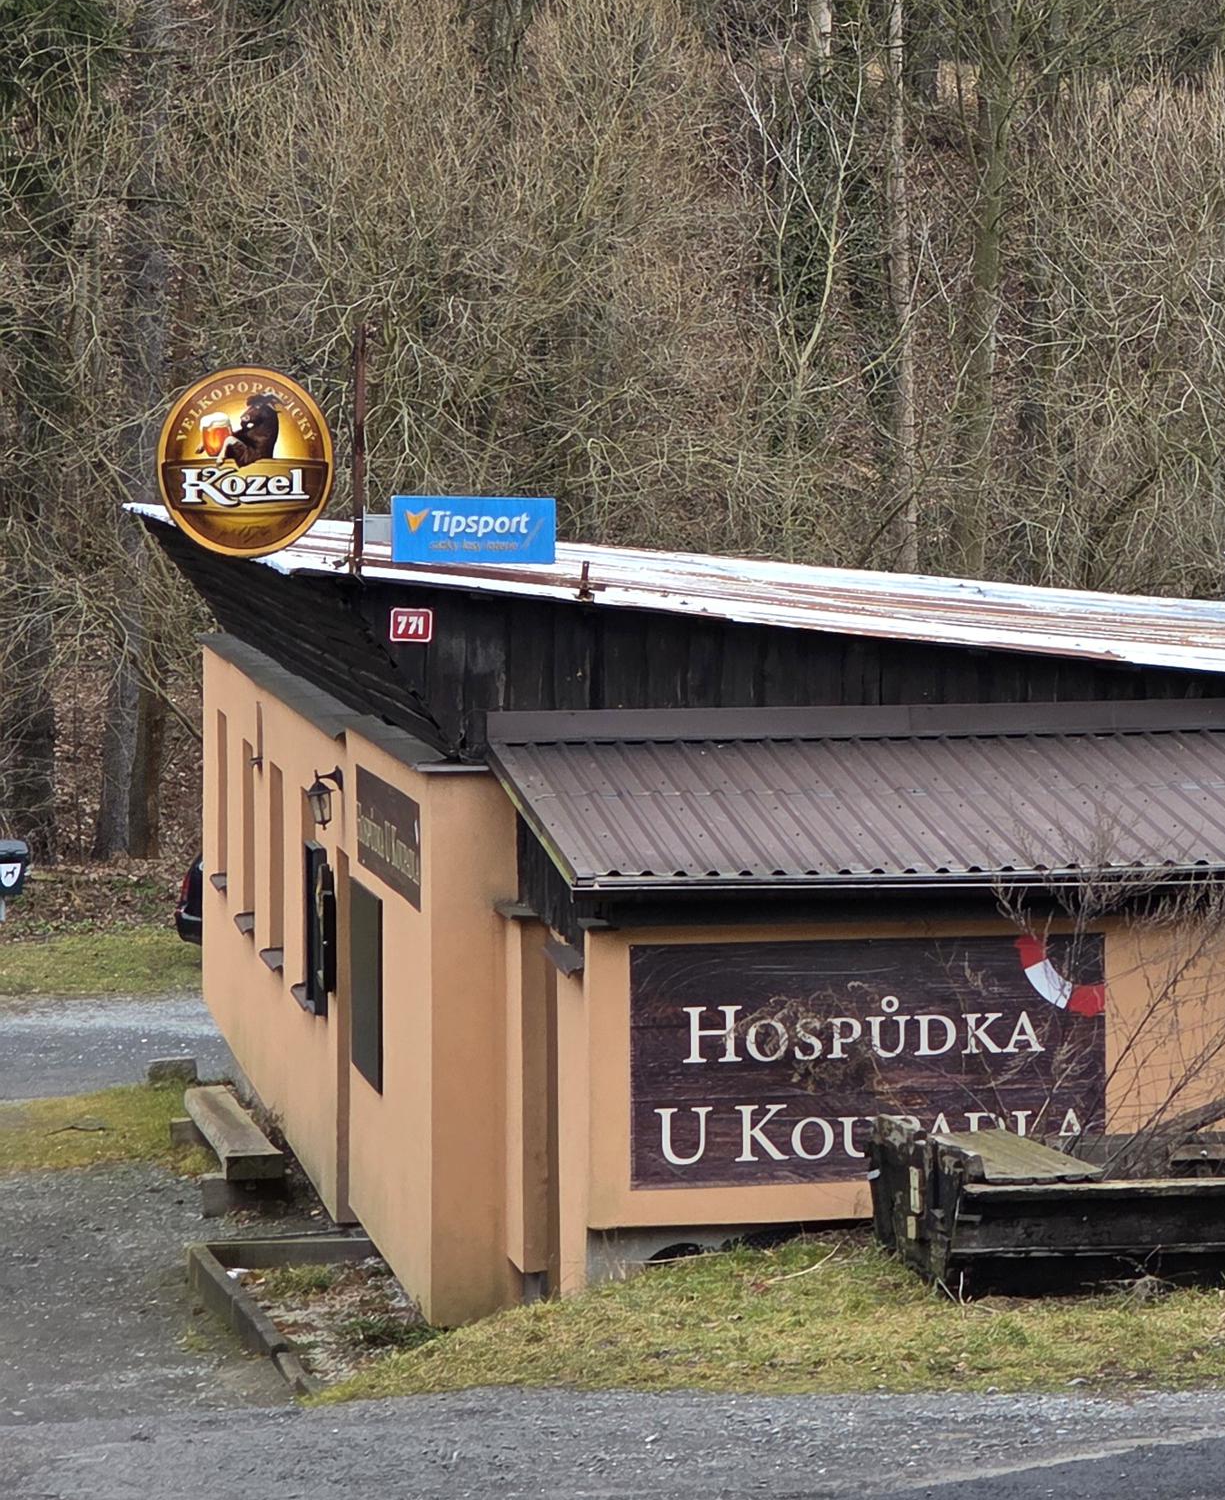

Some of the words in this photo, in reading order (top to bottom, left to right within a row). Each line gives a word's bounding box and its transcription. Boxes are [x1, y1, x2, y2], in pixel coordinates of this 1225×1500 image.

[180, 466, 311, 507] Kozel
[431, 510, 530, 537] Tipsport
[397, 615, 425, 635] 771
[682, 995, 1046, 1064] HOSPŮDKA
[654, 1106, 714, 1166] U
